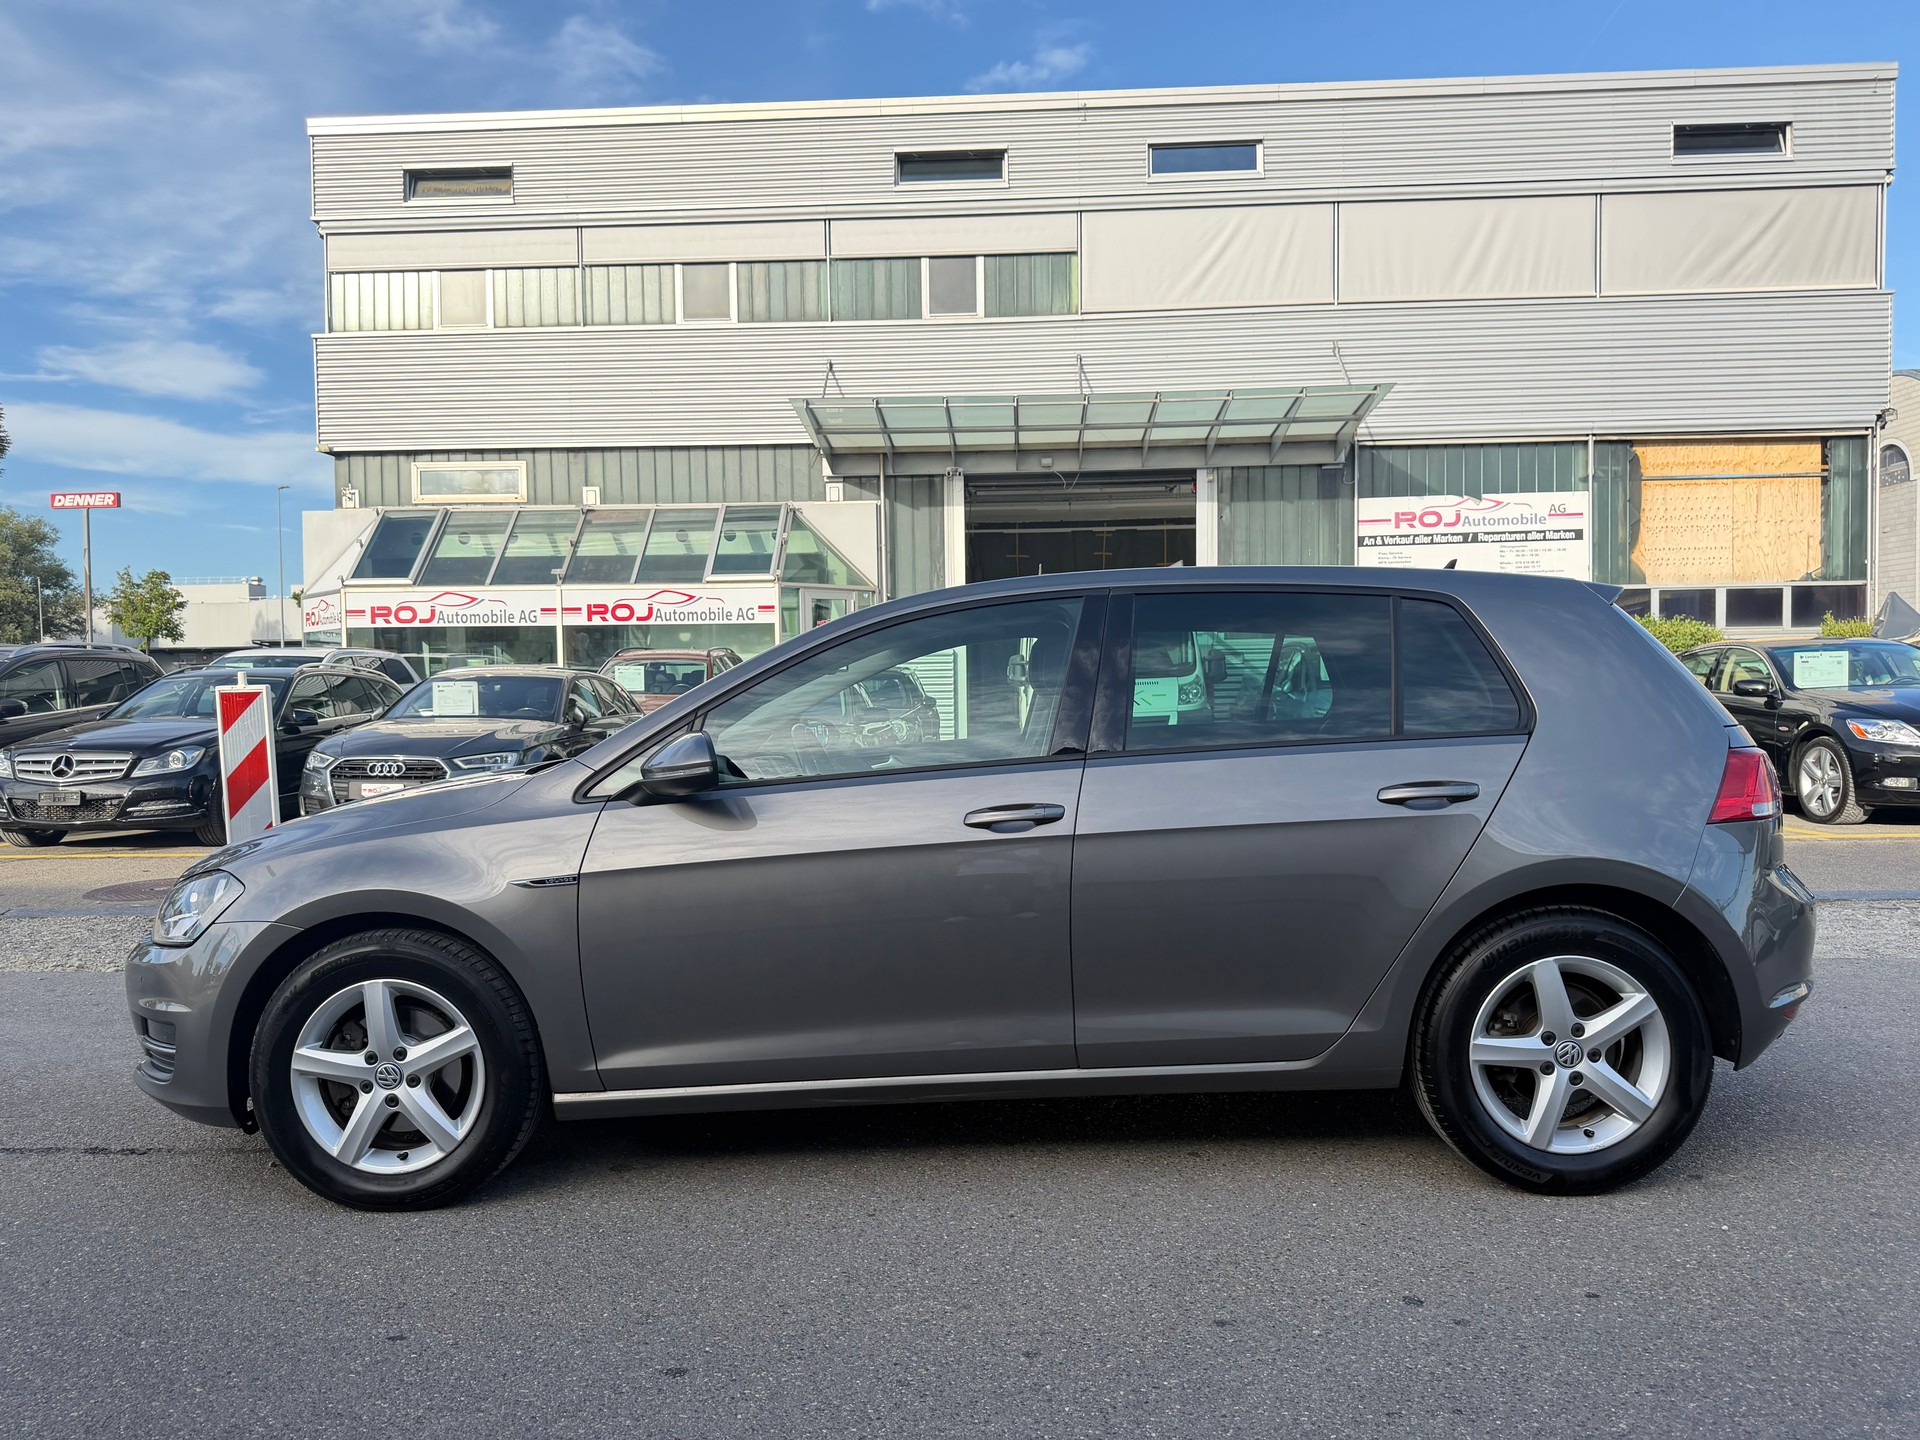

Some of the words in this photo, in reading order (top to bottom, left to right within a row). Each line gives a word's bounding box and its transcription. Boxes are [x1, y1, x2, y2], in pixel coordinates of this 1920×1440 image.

[53, 494, 114, 506] DENNER
[1394, 509, 1461, 529] ROJ
[1462, 513, 1547, 528] Automobile
[1549, 503, 1567, 514] AG
[1363, 536, 1375, 546] An
[1375, 536, 1383, 545] &
[1383, 535, 1413, 545] Verkauf
[1414, 534, 1432, 544] aller
[1432, 533, 1463, 543] Marken
[1477, 532, 1526, 543] Reparaturen
[1526, 531, 1545, 541] aller
[1545, 530, 1576, 540] Marken
[305, 610, 320, 627] ROJ
[370, 605, 436, 624] ROJ
[437, 609, 515, 624] Automobile
[518, 609, 538, 624] AG
[586, 603, 653, 622] ROJ
[654, 606, 733, 622] Automobile
[736, 607, 755, 621] AG
